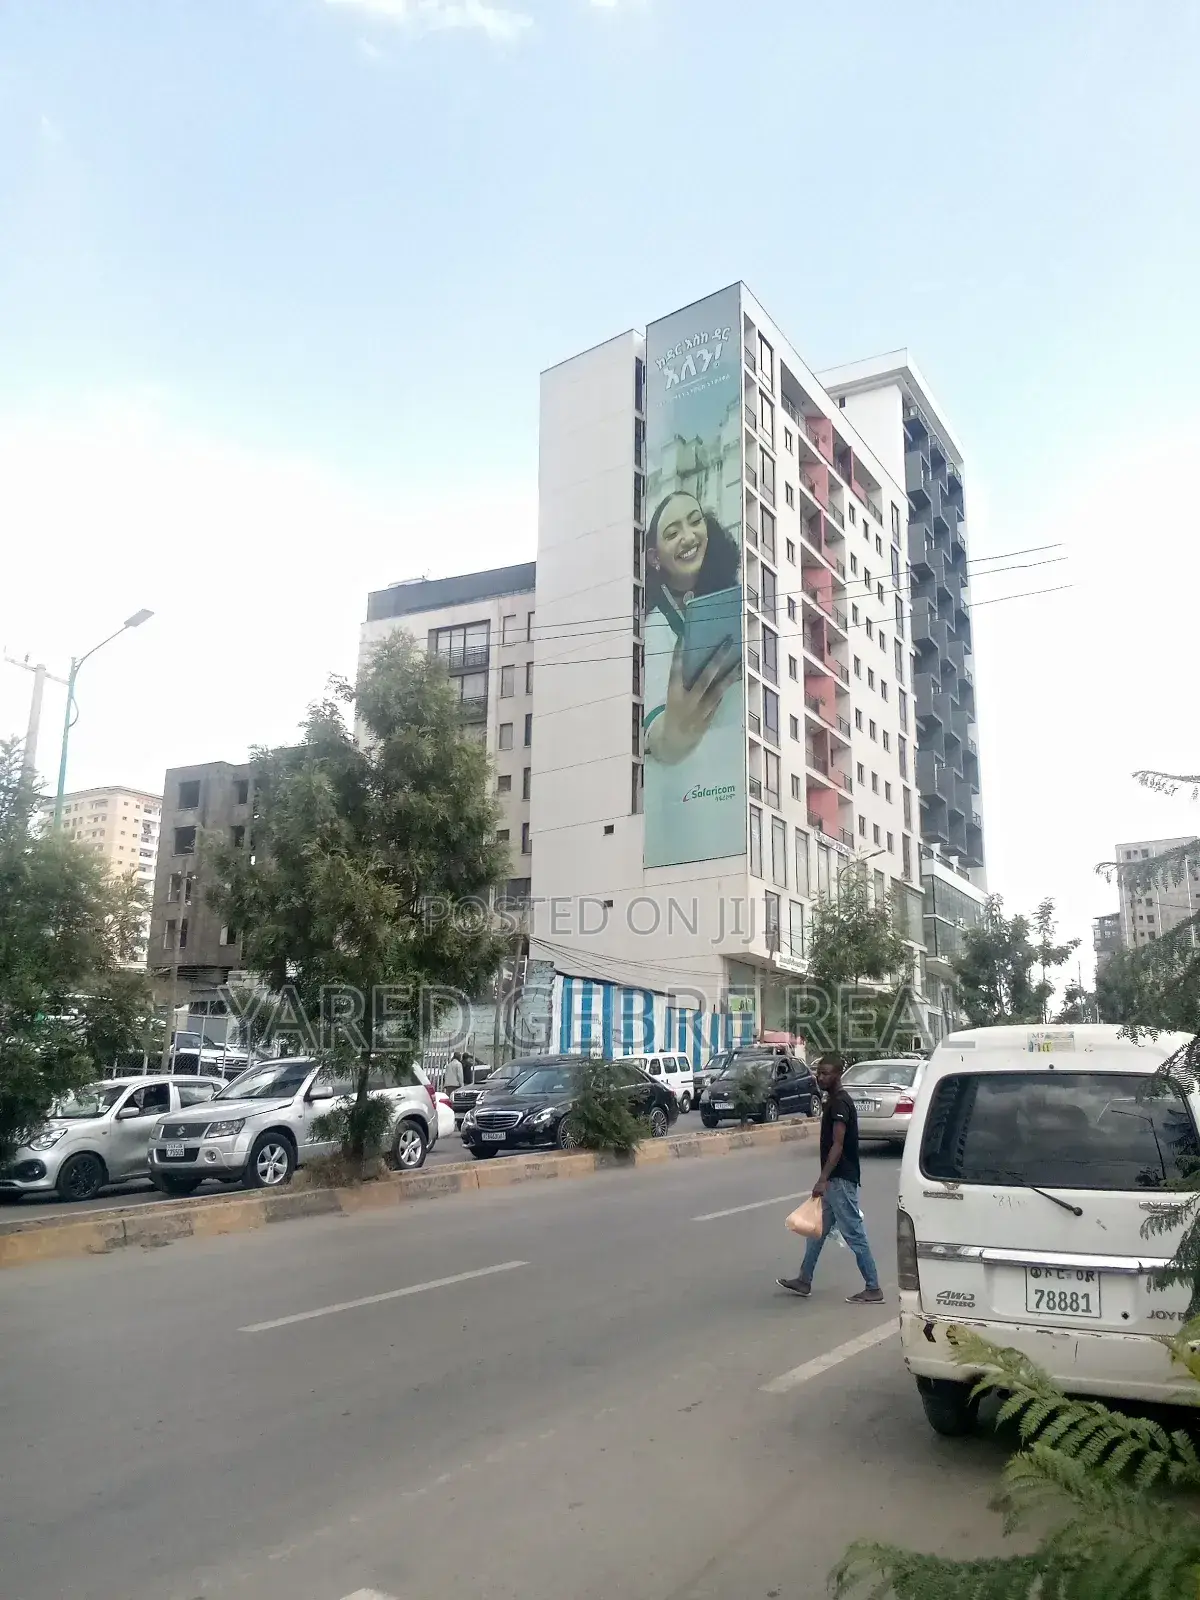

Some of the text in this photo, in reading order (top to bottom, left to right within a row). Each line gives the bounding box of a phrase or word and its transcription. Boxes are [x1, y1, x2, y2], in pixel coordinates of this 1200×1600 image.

[692, 785, 736, 799] Safaricom
[937, 1290, 975, 1300] 4WD
[1034, 1289, 1092, 1313] 78881
[936, 1299, 976, 1308] TURBO
